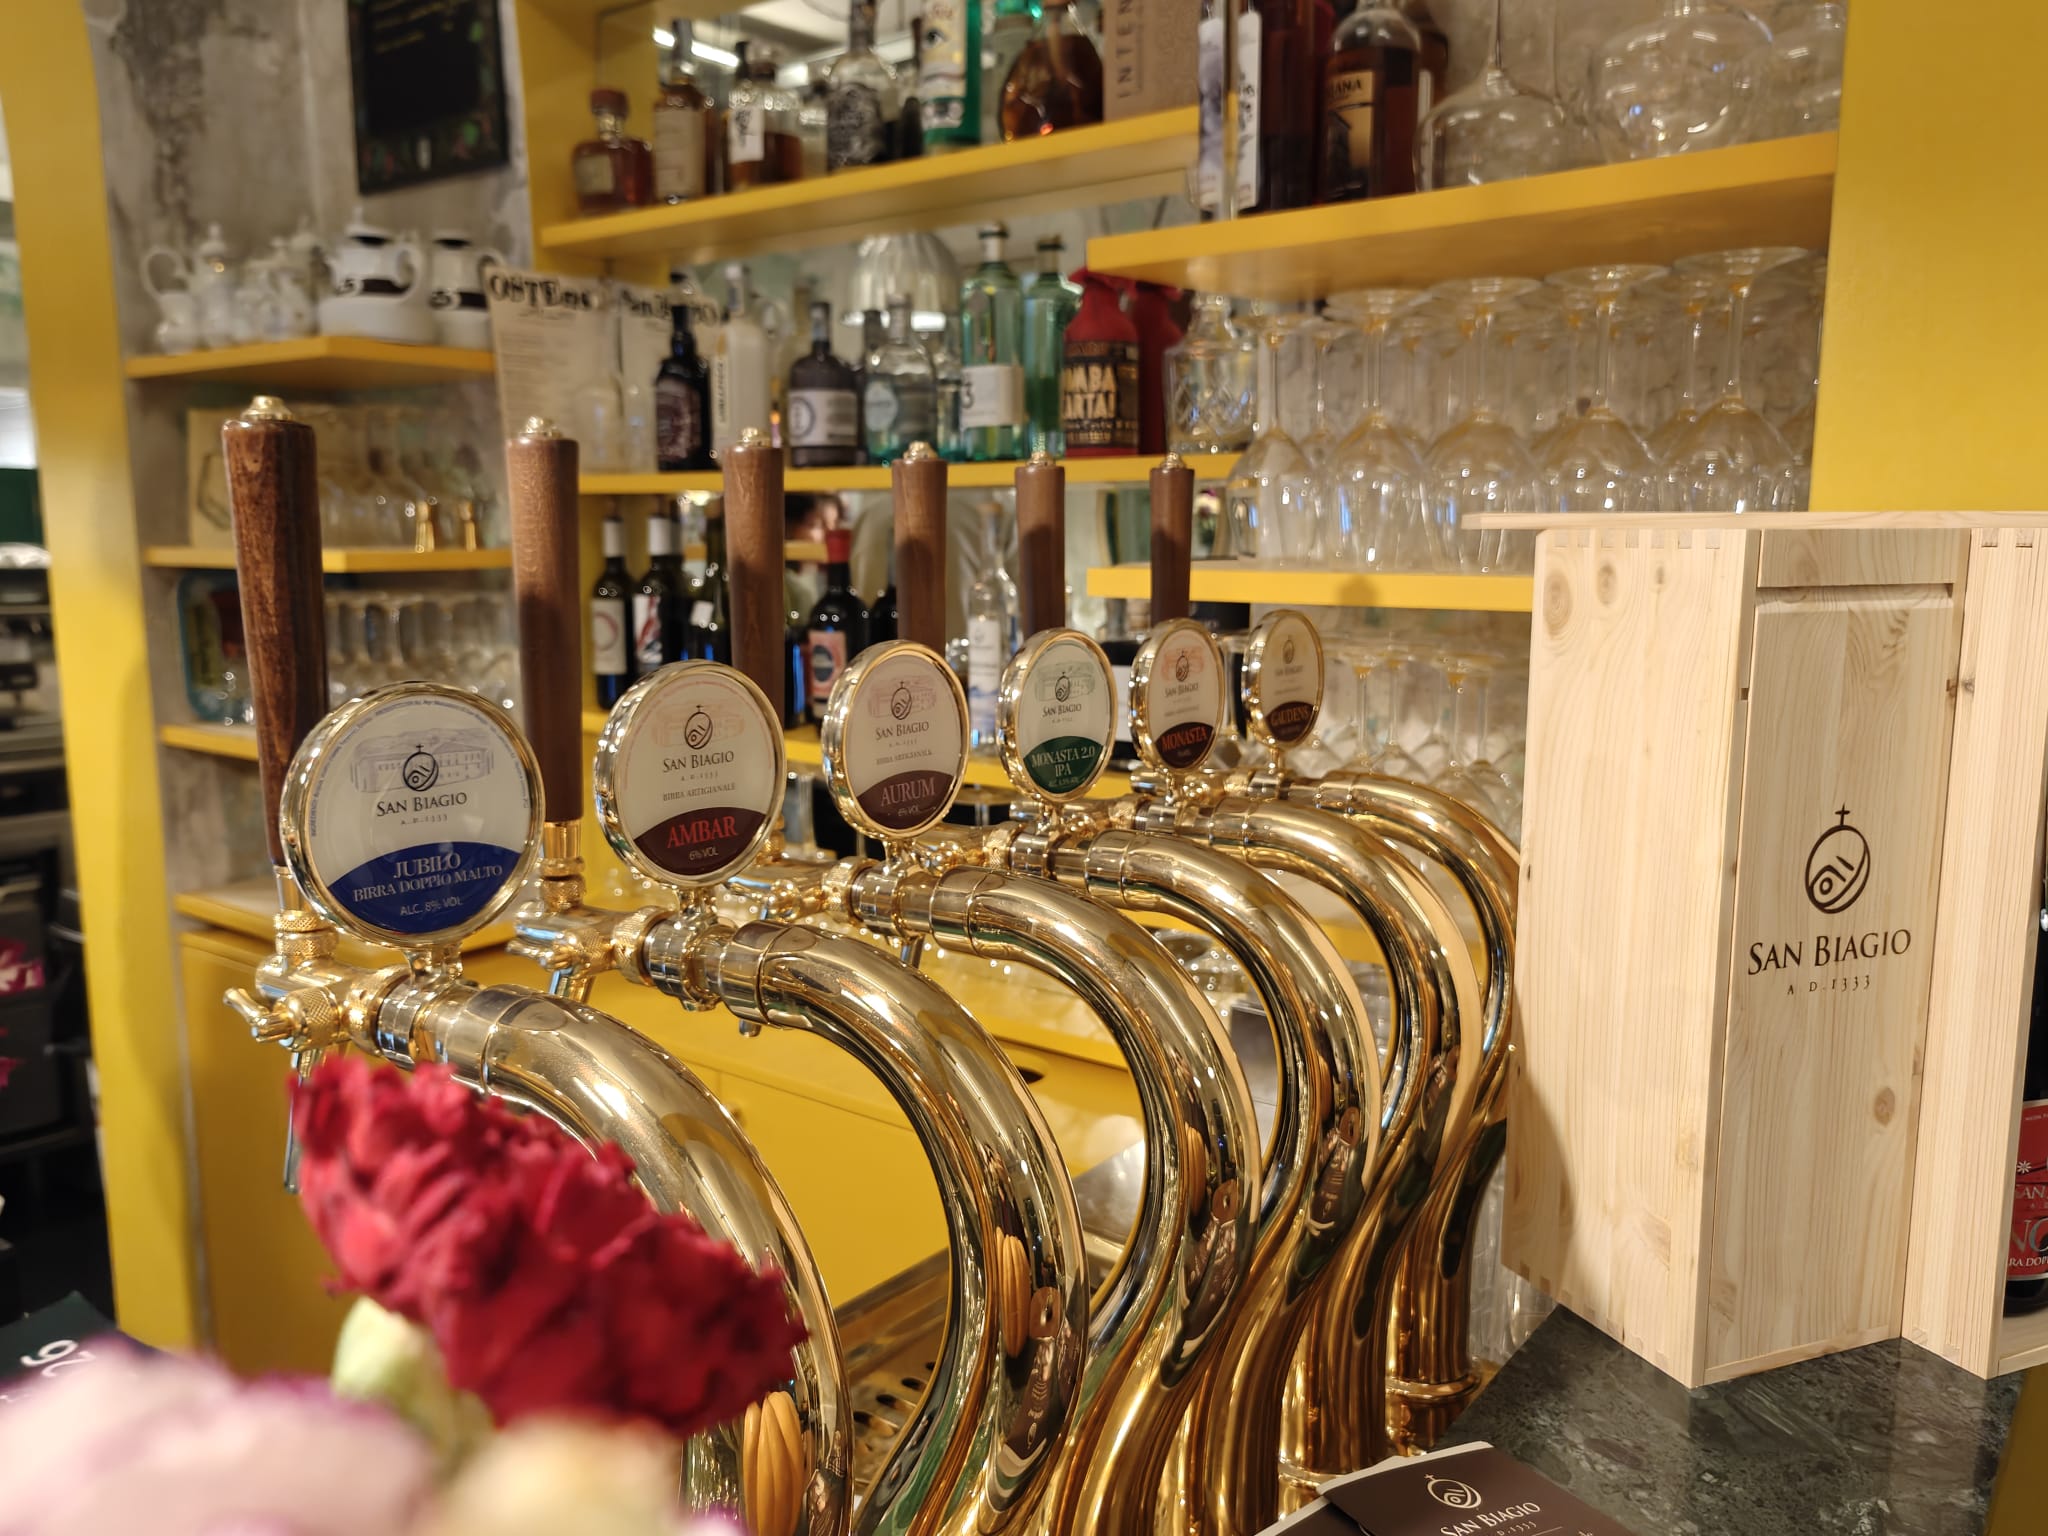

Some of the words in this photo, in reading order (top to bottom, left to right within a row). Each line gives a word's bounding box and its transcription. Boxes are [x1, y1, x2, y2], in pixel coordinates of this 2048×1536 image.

[1042, 706, 1056, 717] SAN
[1058, 703, 1082, 715] BIAGIO
[875, 727, 894, 741] SAN
[896, 721, 930, 737] BIAGIO
[1162, 726, 1207, 752] MONASTA
[663, 756, 687, 773] SAN
[691, 750, 735, 769] BIAGIO
[1031, 748, 1080, 768] MONASTA
[1055, 762, 1072, 777] IPA
[377, 800, 407, 817] SAN
[413, 792, 468, 812] BIAGIO
[881, 777, 936, 807] AURUM
[667, 815, 738, 849] AMBAR
[393, 852, 462, 879] JUBILO
[353, 884, 397, 902] BIRRA
[400, 875, 451, 893] DOPPIO
[454, 865, 503, 883] MALTO
[1748, 942, 1802, 975] SAN
[1815, 929, 1911, 967] BIAGIO
[1441, 1519, 1481, 1536] SAN
[1476, 1502, 1541, 1527] BIAGIO
